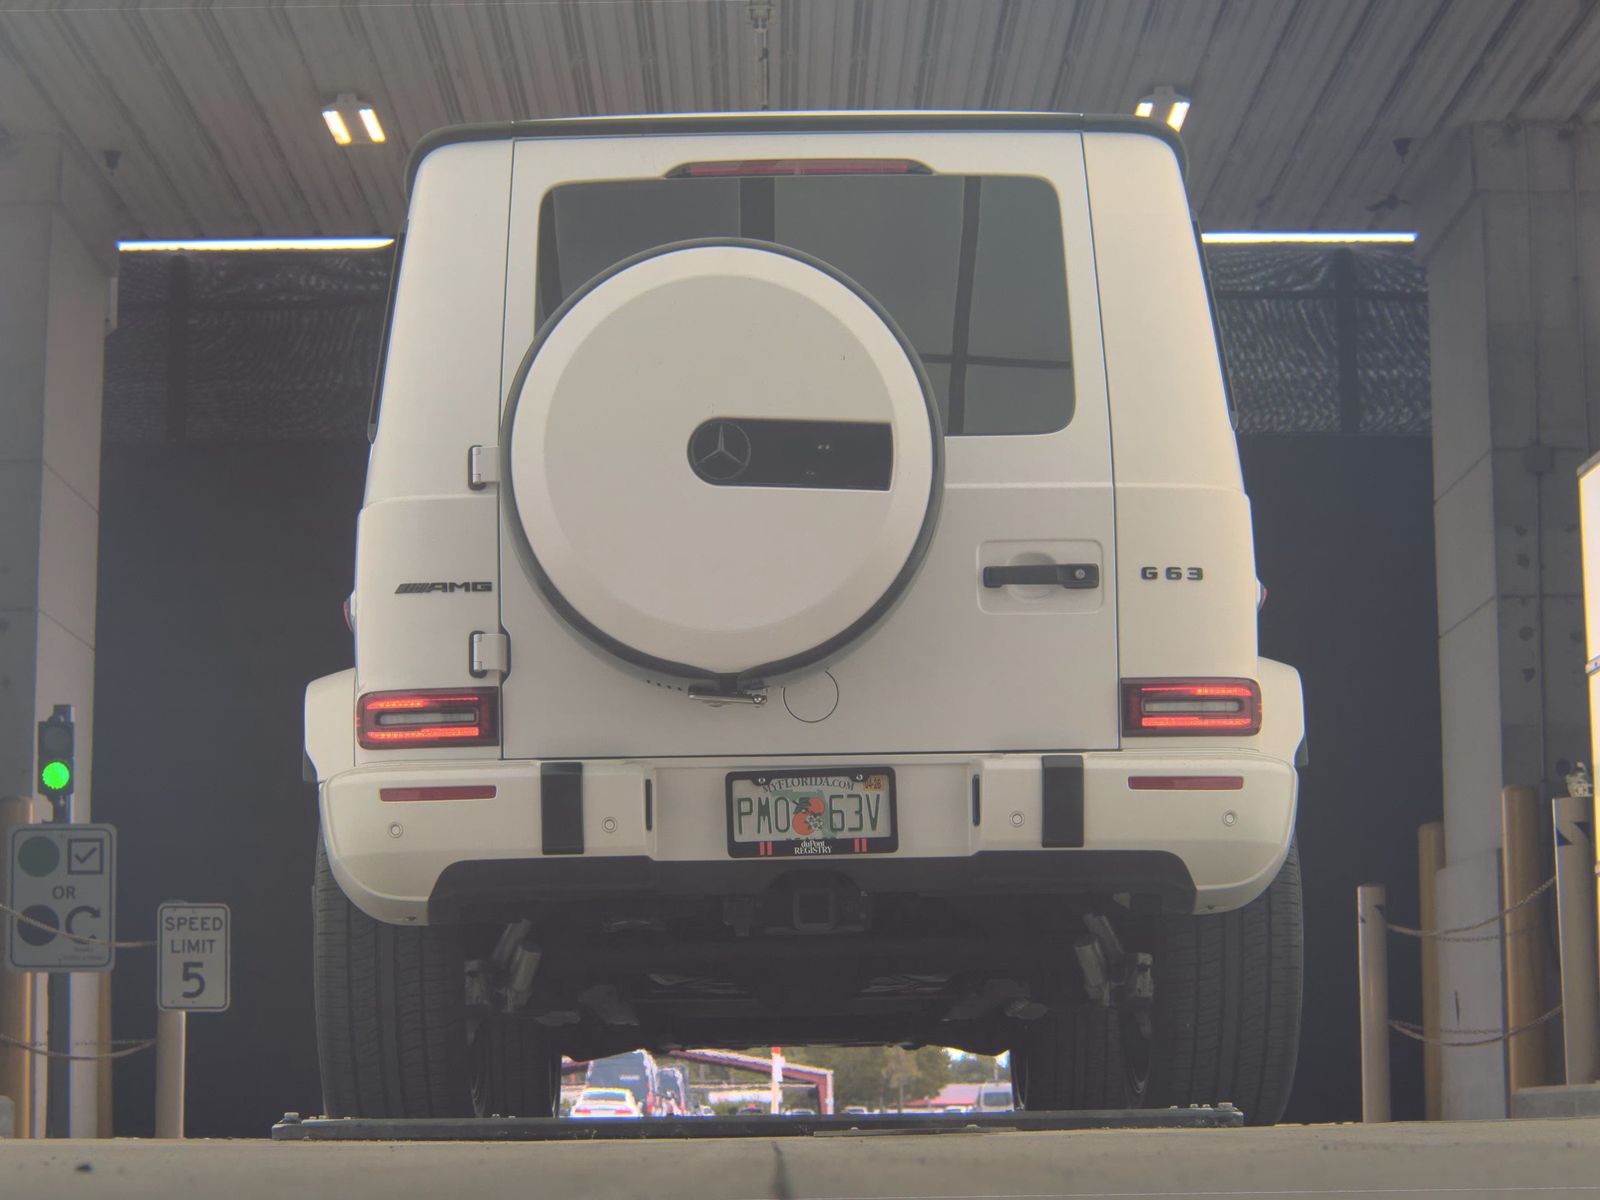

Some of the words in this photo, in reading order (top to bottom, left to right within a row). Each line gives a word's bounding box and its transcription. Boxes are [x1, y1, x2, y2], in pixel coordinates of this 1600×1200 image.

[1141, 566, 1158, 580] G
[1165, 566, 1203, 580] 63
[427, 581, 493, 593] AMG
[762, 777, 855, 793] MYFLORIDA.COM
[794, 845, 832, 855] REGISTRY
[800, 840, 825, 848] duPont
[52, 885, 77, 900] OR
[165, 916, 223, 932] SPEED
[170, 939, 216, 954] LIMIT
[181, 960, 206, 999] 5
